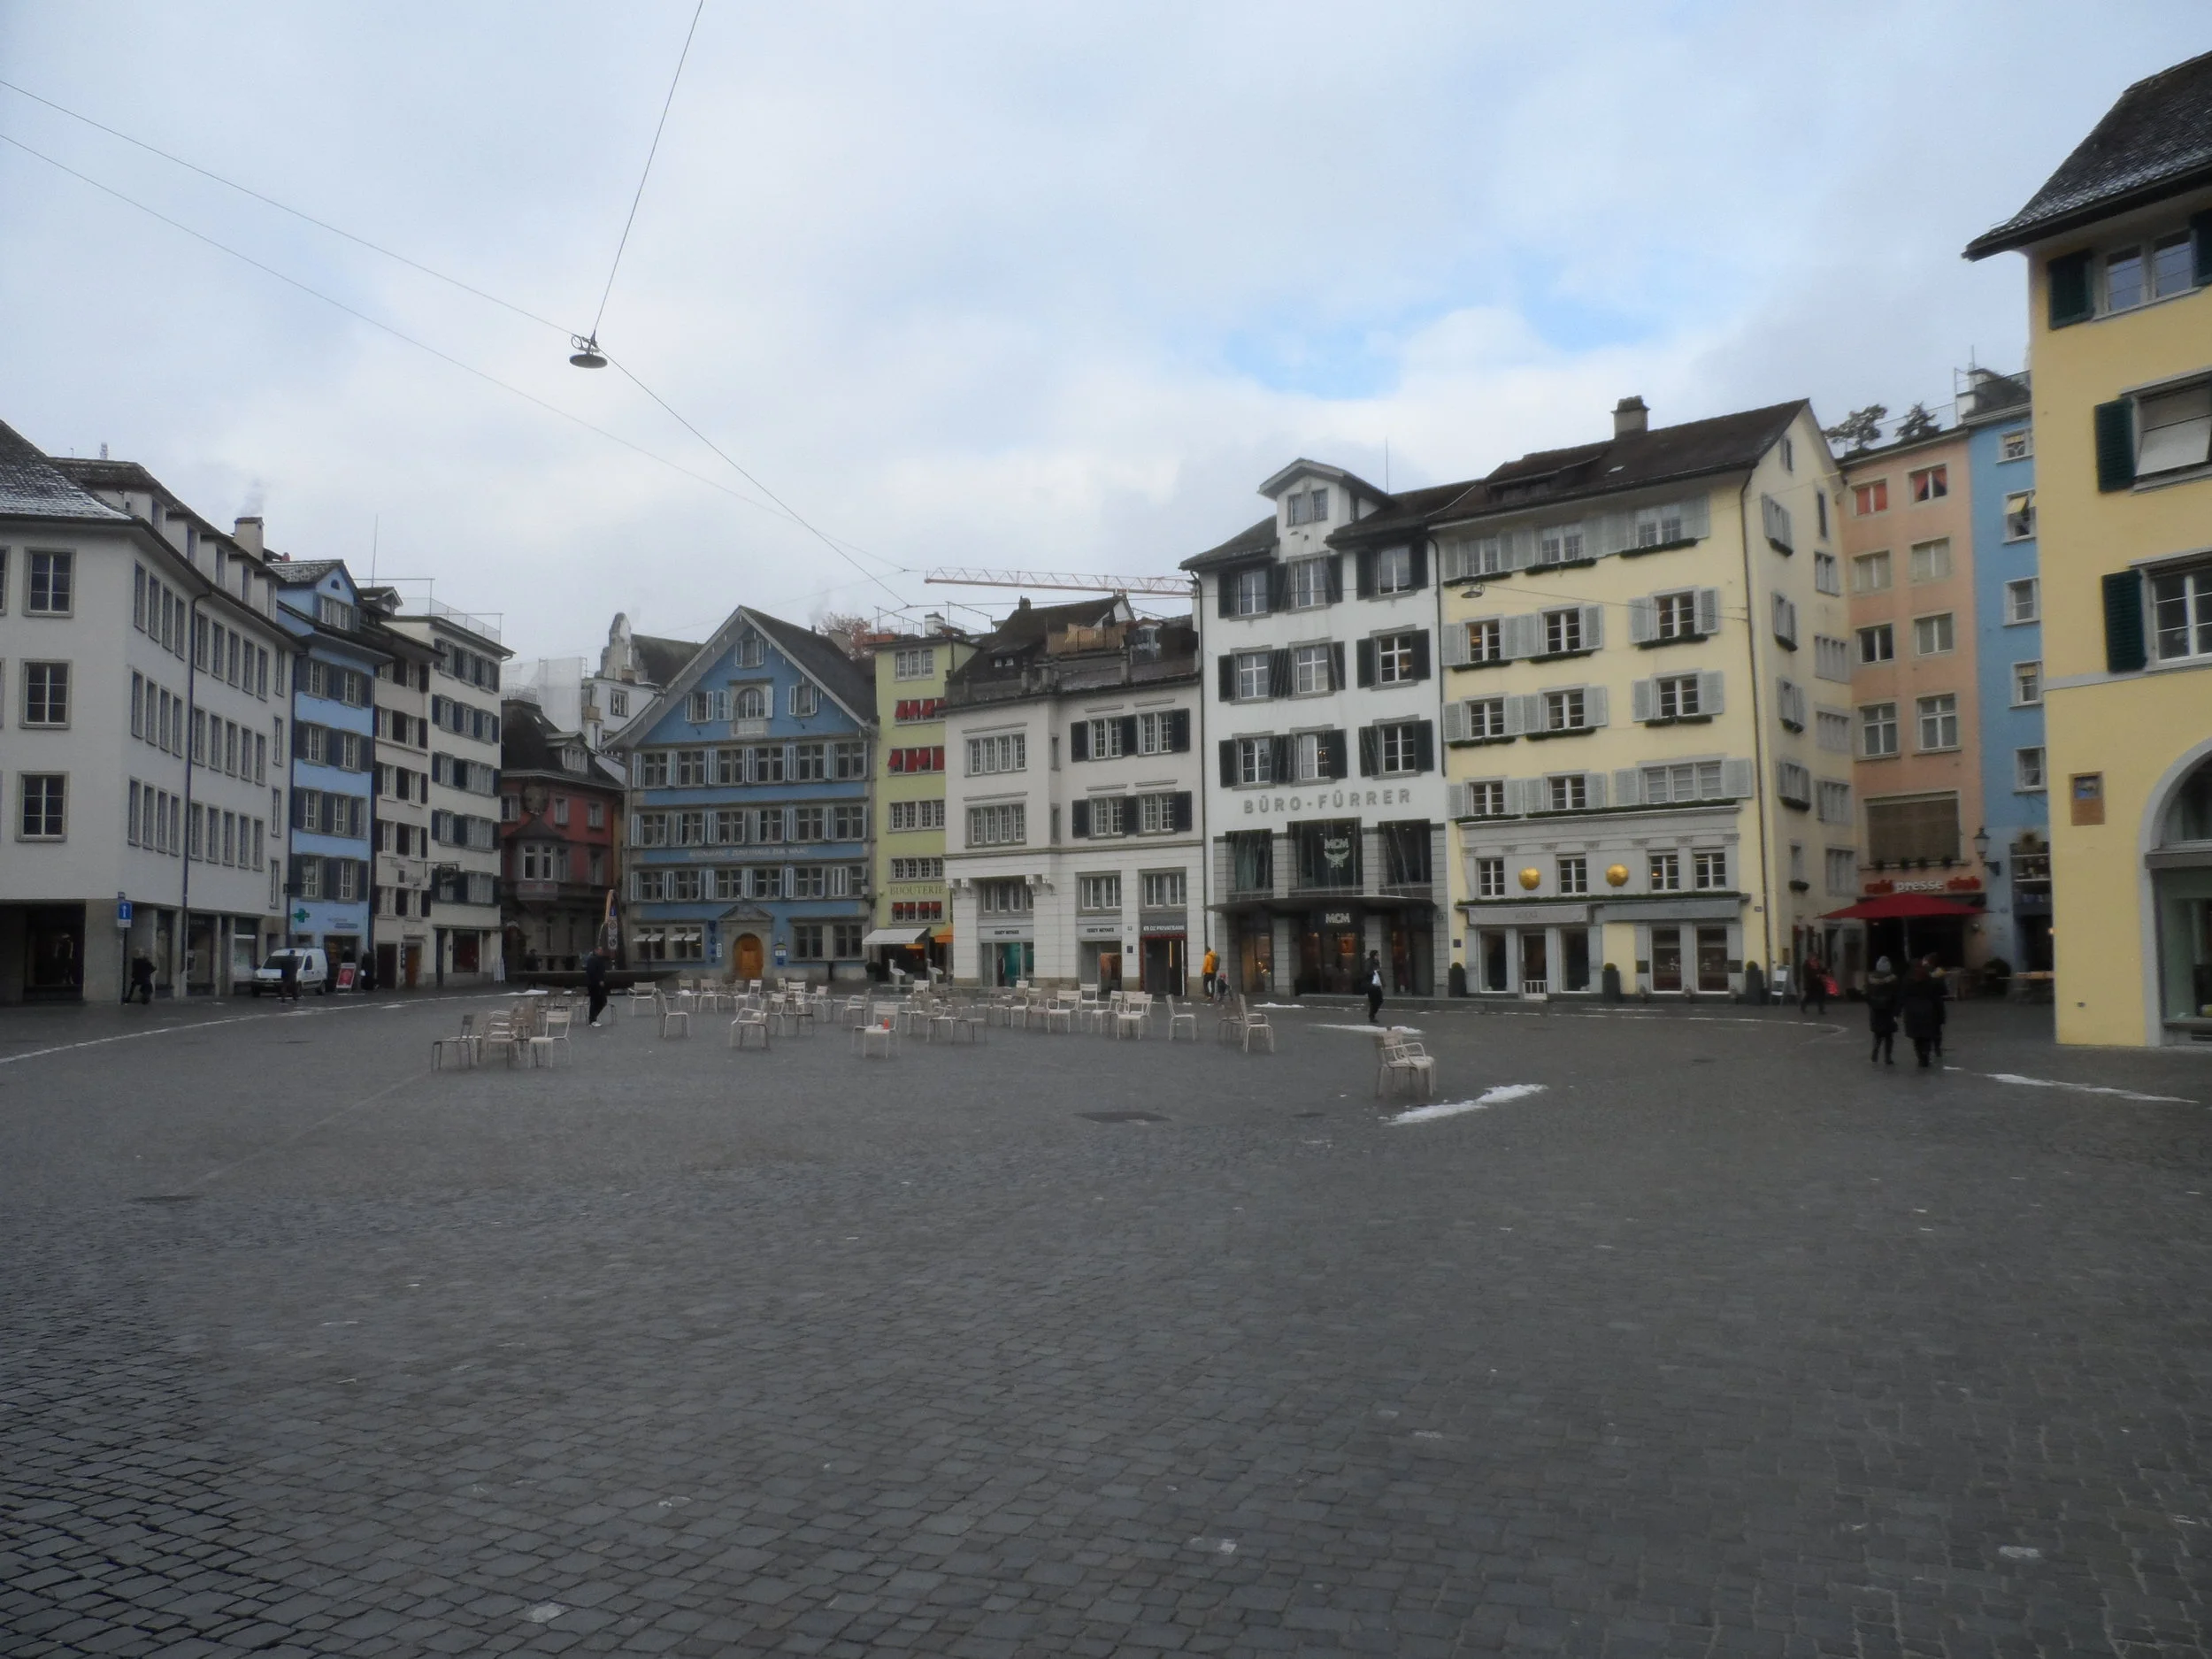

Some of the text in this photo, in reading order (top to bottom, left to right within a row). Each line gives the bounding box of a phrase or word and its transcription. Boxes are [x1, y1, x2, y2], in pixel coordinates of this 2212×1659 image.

[1325, 838, 1349, 849] MCM
[889, 885, 944, 895] BIJOUTERIE
[1896, 879, 1944, 893] presse
[1325, 913, 1350, 924] MCM
